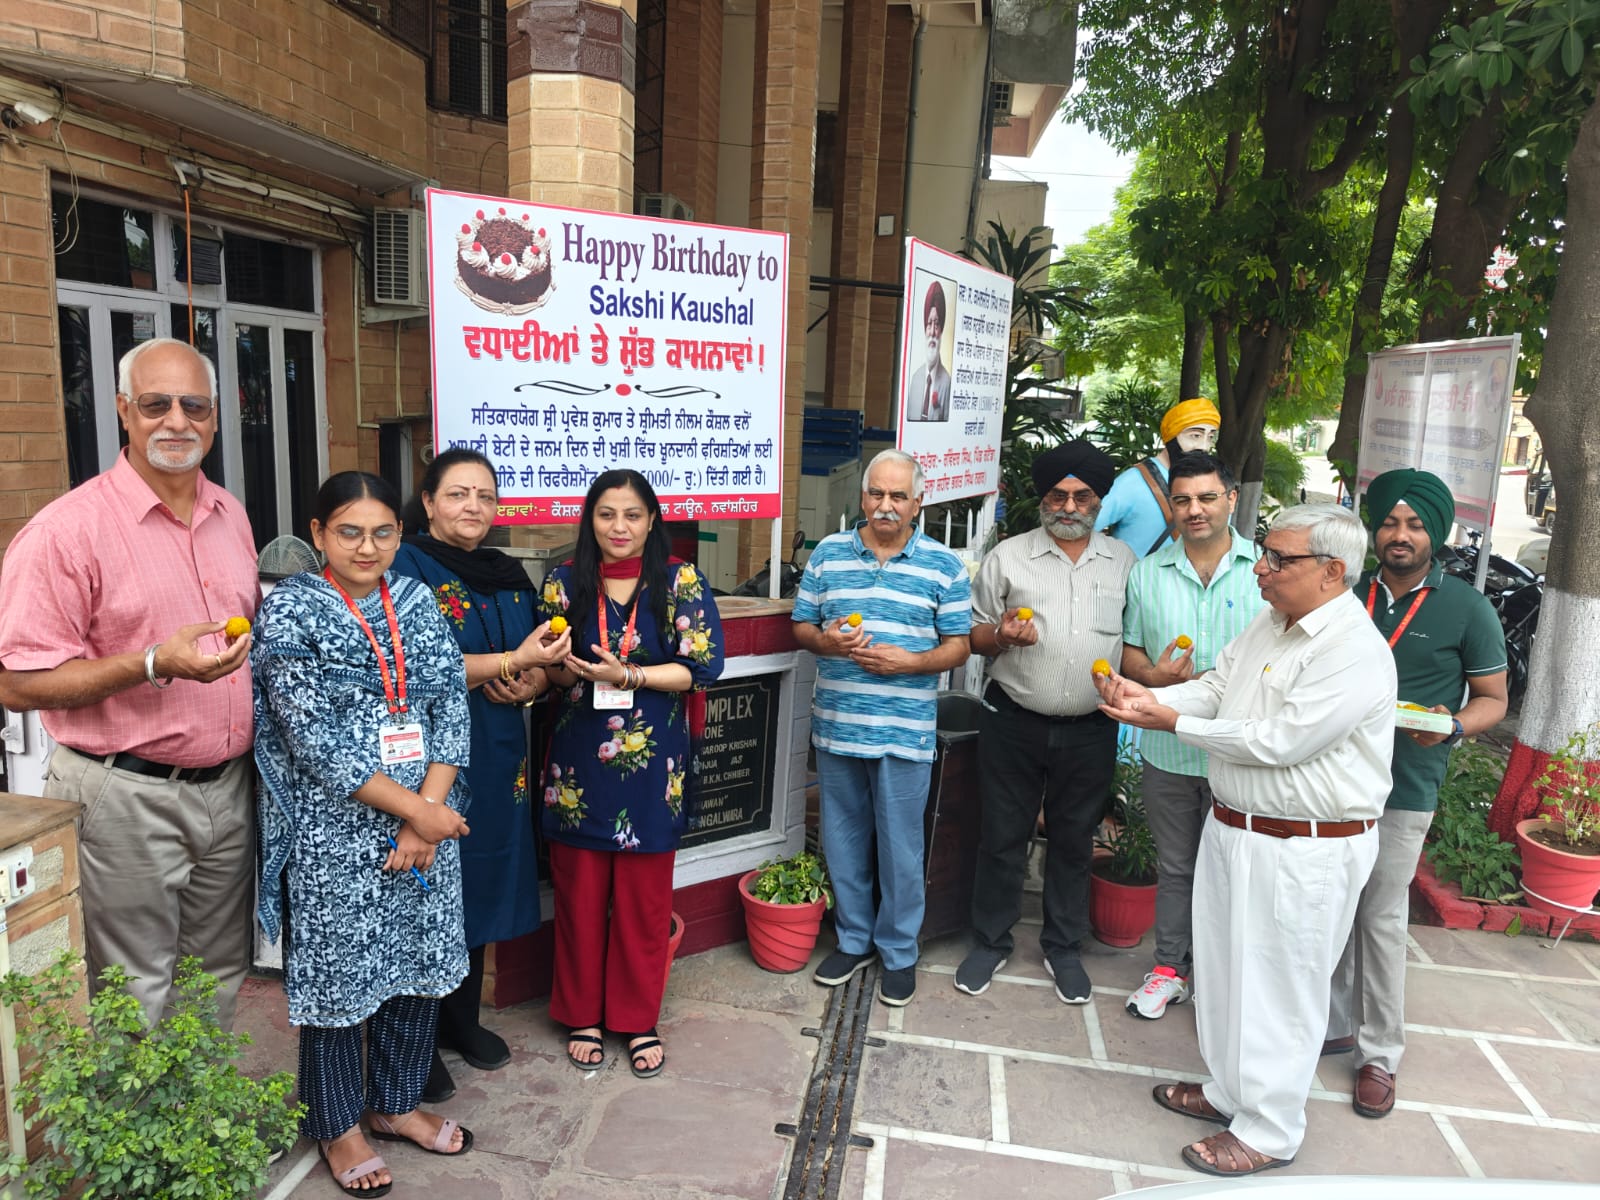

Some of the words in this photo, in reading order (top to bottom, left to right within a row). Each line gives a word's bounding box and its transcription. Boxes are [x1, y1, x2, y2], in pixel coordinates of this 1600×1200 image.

[562, 222, 645, 283] Happy
[651, 233, 751, 292] Birthday
[757, 249, 778, 281] to
[590, 285, 664, 320] Sakshi
[671, 292, 754, 326] Kaushal
[463, 319, 580, 364] ਵਧਾਈਆਂ
[590, 323, 609, 365] ਤੇ
[471, 402, 539, 427] ਸਤਿਕਾਰਯੋਗ
[593, 411, 622, 433] ਕੁਮਾਰ
[626, 407, 635, 429] ਤੇ
[675, 408, 702, 430] ਨੀਲਮ
[705, 408, 730, 431] ਕੌਸ਼ਲ
[734, 409, 752, 431] ਵਲੋਂ
[492, 434, 516, 457] ਬੇਟੀ
[520, 434, 530, 457] ਦੇ
[534, 440, 562, 457] ਜਨਮ
[566, 434, 589, 457] ਦਿਨ
[593, 435, 606, 458] ਦੀ
[634, 436, 656, 458] ਵਿੱਚ
[754, 437, 773, 459] ਲਈ
[496, 465, 516, 488] ਹੀਨੇ
[520, 465, 534, 488] ਦੀ
[706, 465, 729, 486] ਦਿੱਤੀ
[732, 465, 751, 486] ਗਈ
[705, 694, 754, 723] MPLEX
[704, 724, 724, 739] ONE
